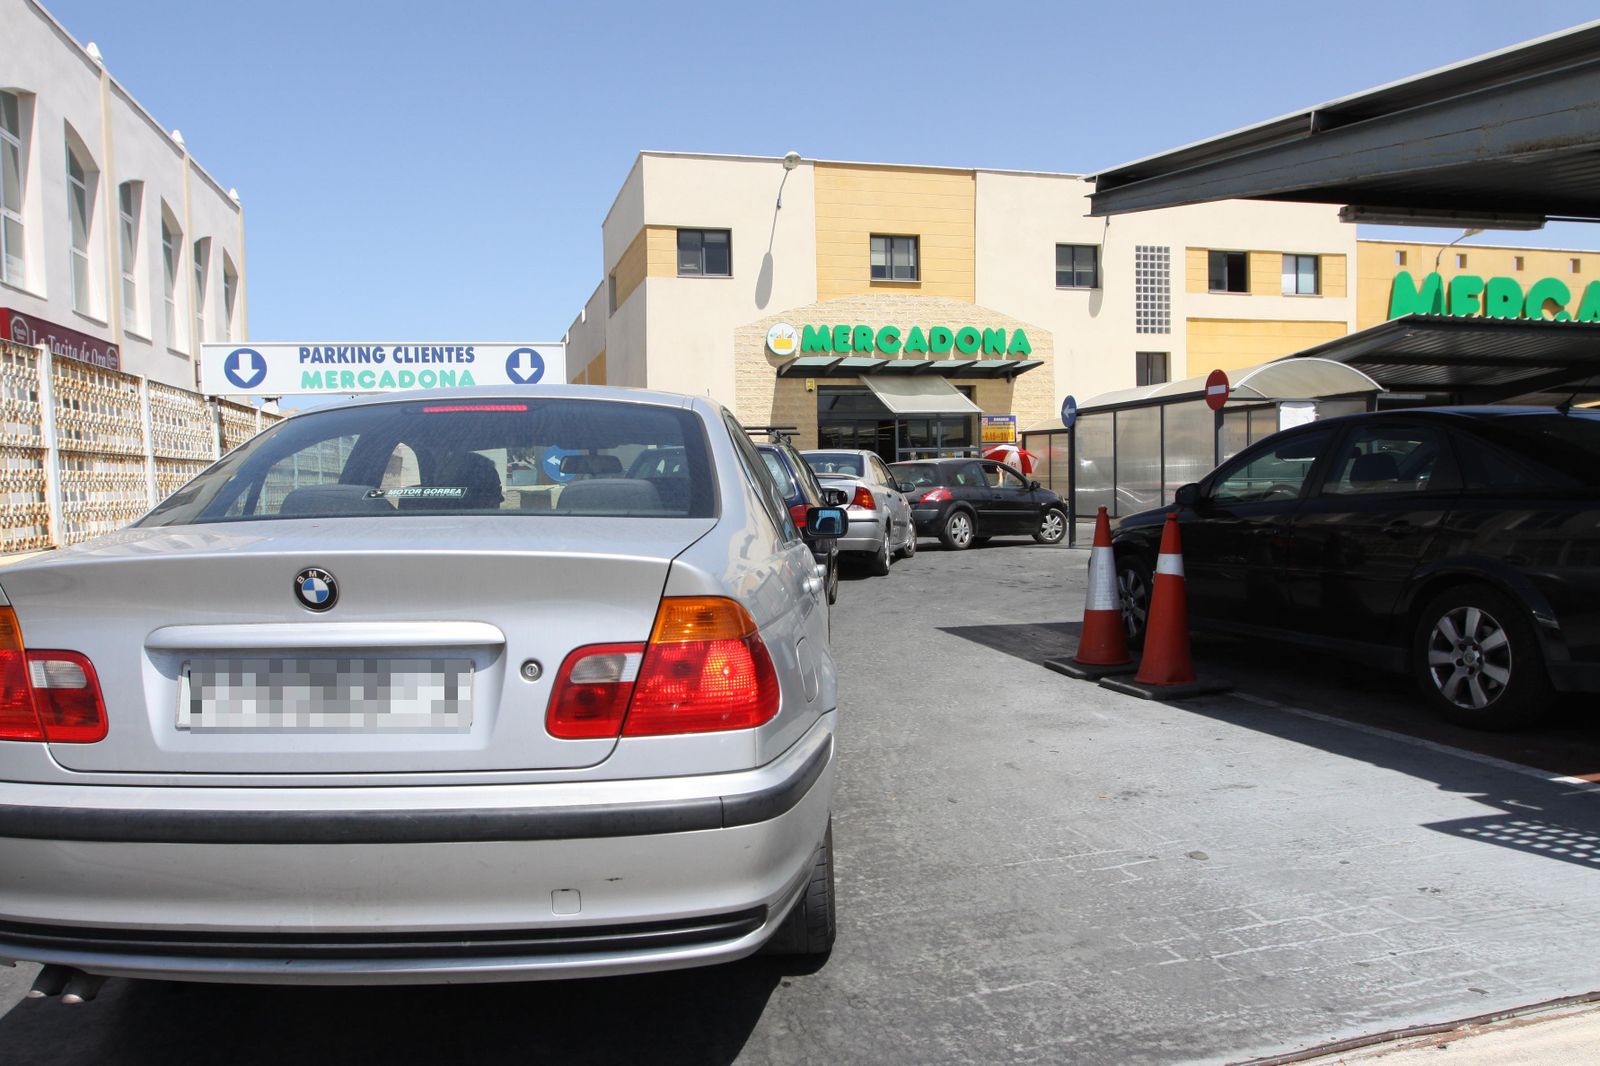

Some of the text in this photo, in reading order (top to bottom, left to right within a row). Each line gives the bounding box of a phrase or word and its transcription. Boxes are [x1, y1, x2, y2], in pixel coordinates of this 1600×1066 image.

[801, 324, 1032, 355] MERCADONA
[299, 346, 476, 364] PARKING CLIENTES
[301, 369, 476, 389] MERCADONA
[296, 570, 332, 584] BMW
